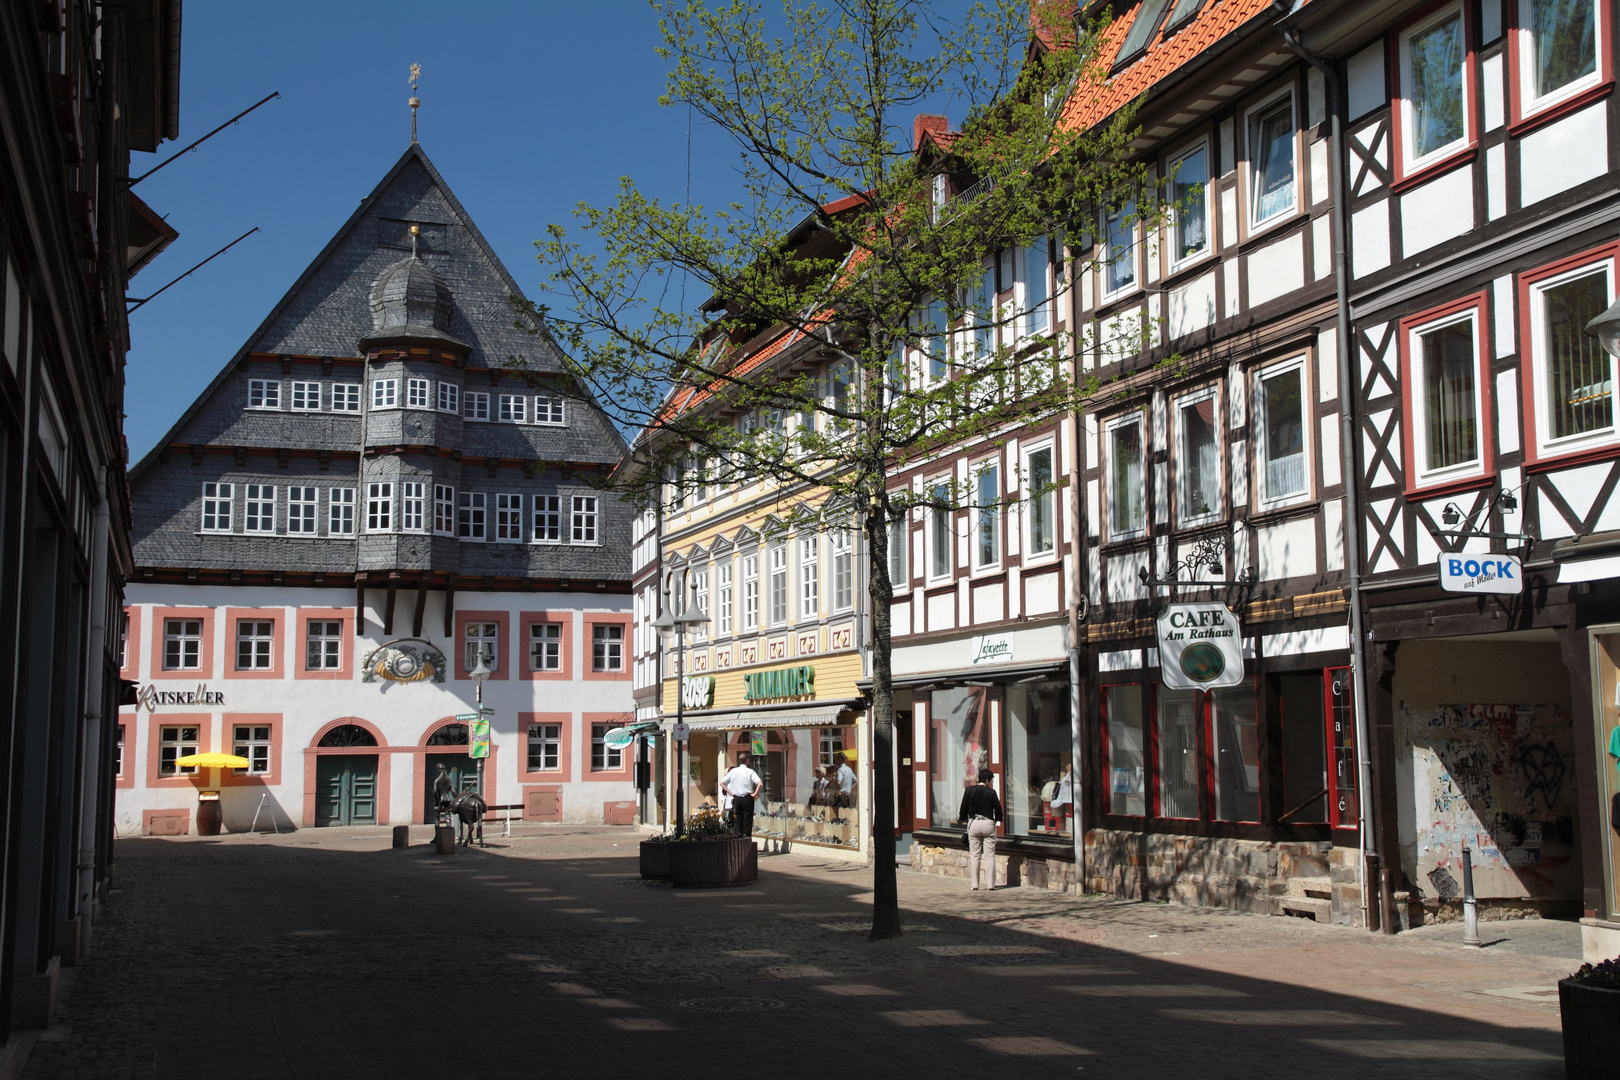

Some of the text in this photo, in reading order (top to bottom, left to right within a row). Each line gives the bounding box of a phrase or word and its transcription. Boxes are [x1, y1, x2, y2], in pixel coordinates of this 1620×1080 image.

[1449, 559, 1514, 579] BOCK
[1170, 610, 1225, 628] CAFE
[1165, 628, 1234, 641] Am Rathaus
[973, 634, 1013, 664] Lafayette
[743, 665, 815, 701] SALAMANDER
